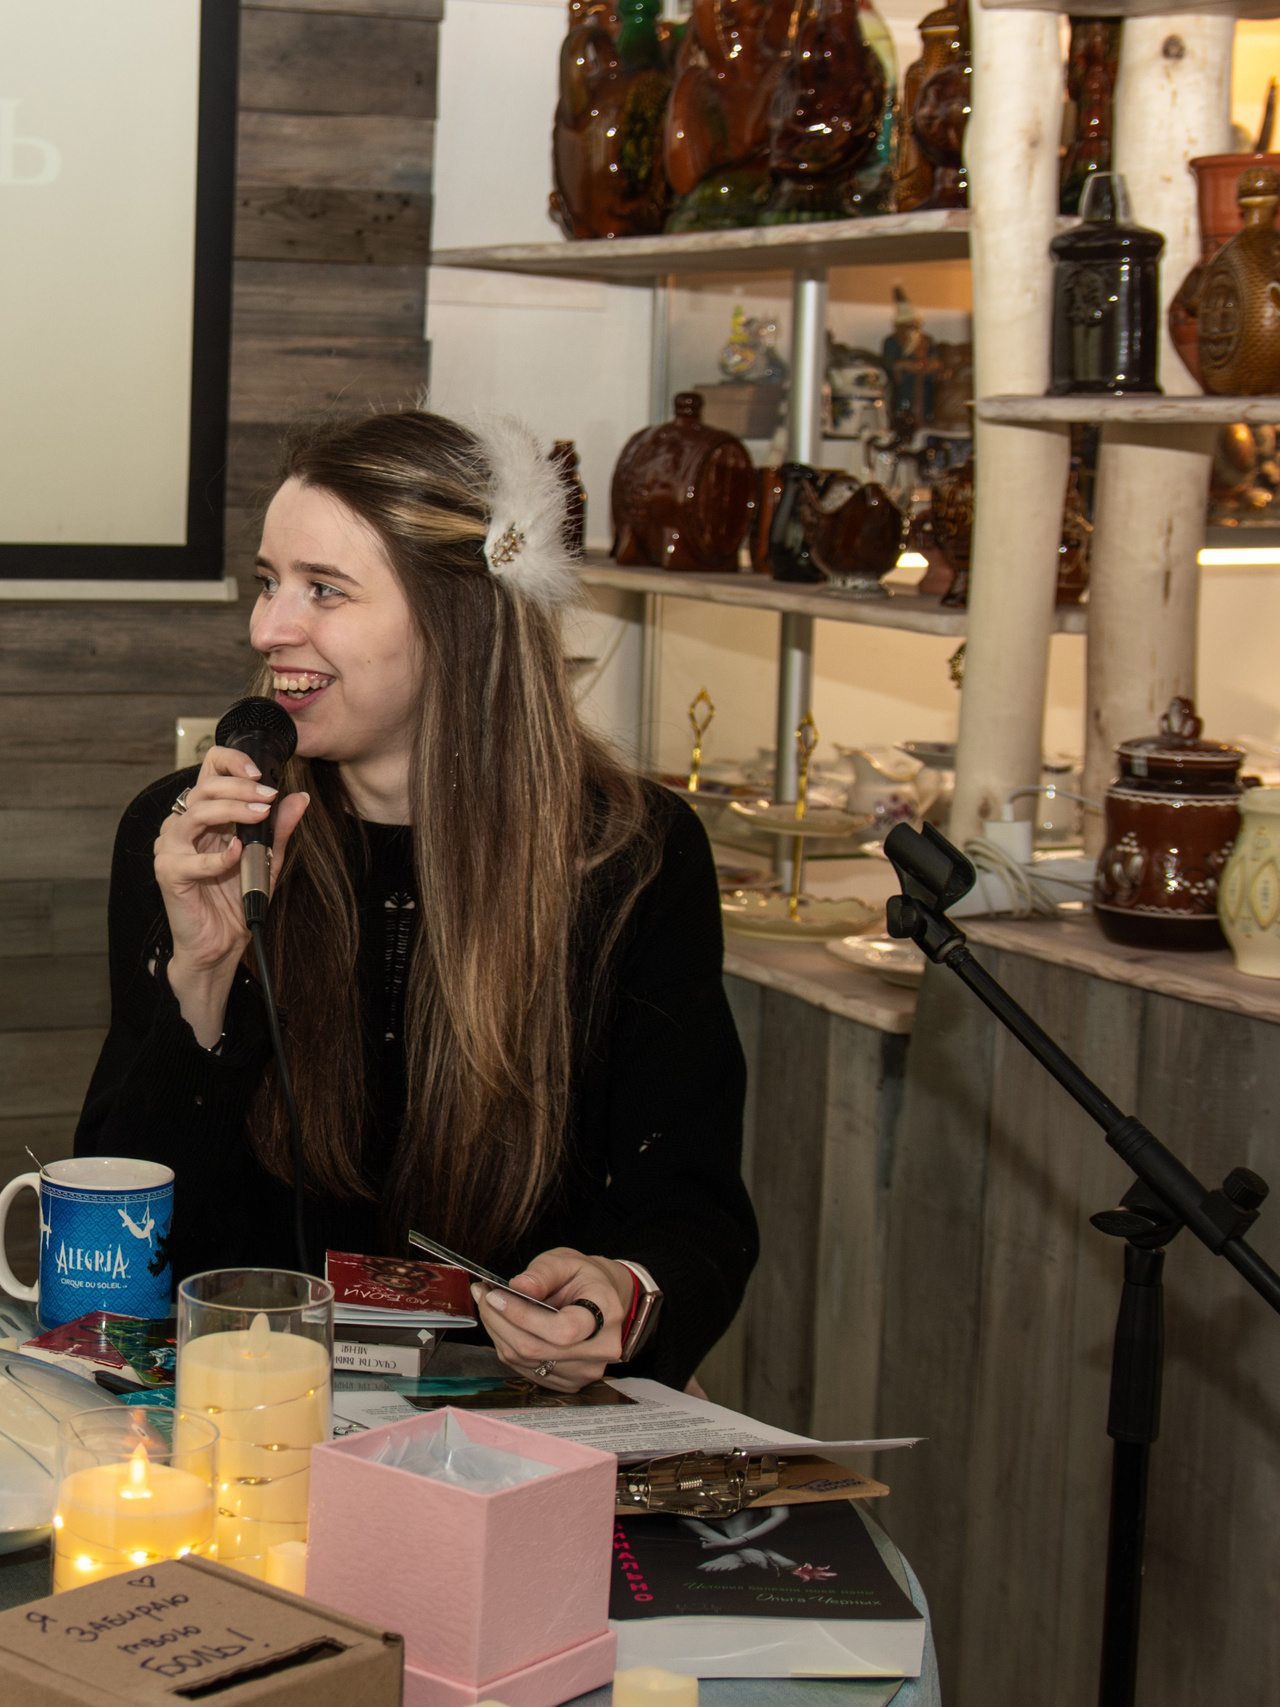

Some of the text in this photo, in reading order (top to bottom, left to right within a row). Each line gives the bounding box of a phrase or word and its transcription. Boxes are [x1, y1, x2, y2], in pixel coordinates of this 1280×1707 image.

[60, 1278, 122, 1290] CIRQUE DU SOLEIL
[340, 1344, 369, 1355] МЕНЯ!
[334, 1355, 397, 1370] СЧАСТЬЕ ВЫБ
[683, 1581, 745, 1591] История
[755, 1592, 882, 1607] Ольга Черных
[25, 1610, 58, 1634] Я
